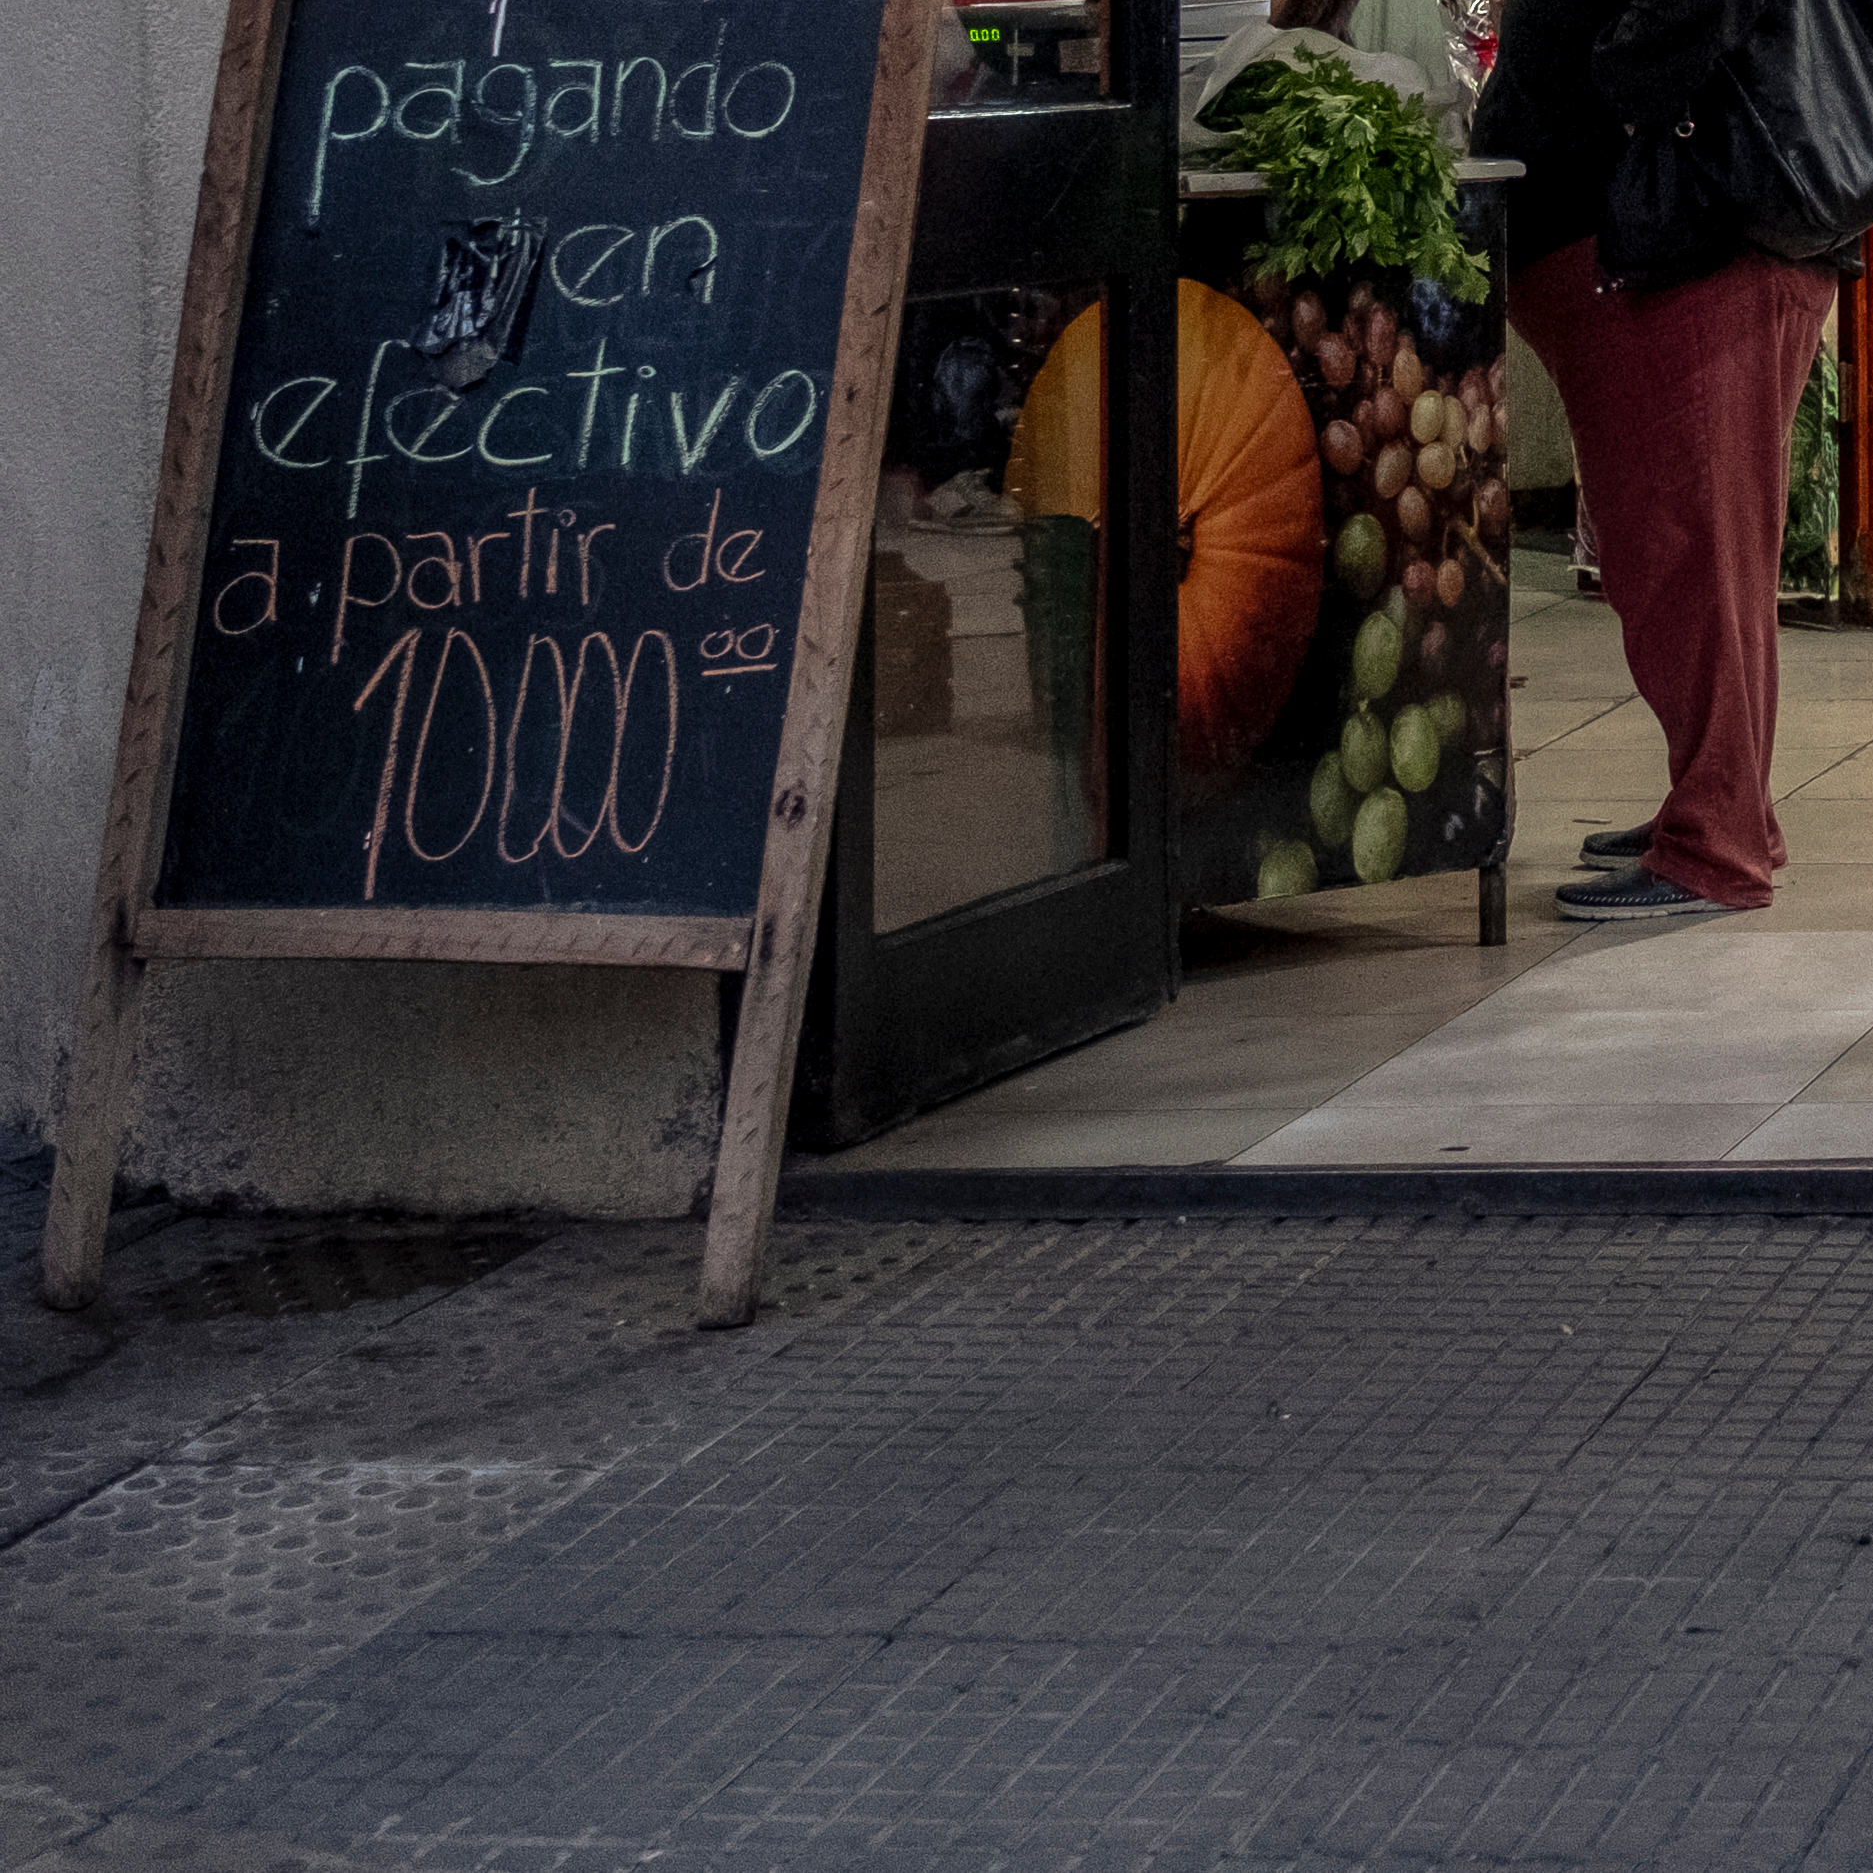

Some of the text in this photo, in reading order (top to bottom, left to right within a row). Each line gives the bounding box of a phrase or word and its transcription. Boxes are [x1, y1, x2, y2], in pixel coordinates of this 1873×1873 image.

[308, 19, 797, 232] pagando
[552, 214, 718, 307] en
[252, 338, 817, 521] efectivo
[214, 488, 766, 664] a partir de
